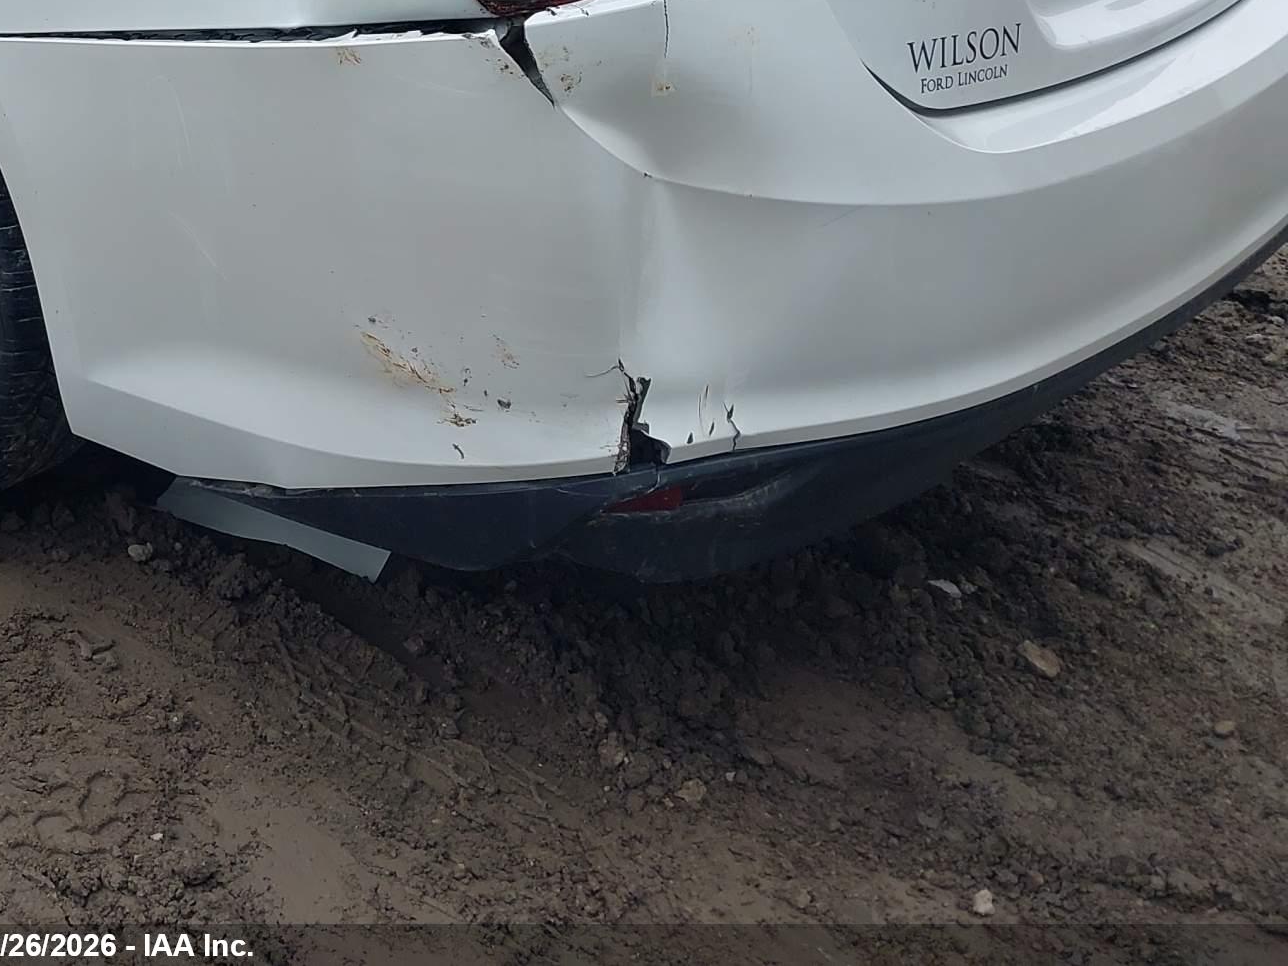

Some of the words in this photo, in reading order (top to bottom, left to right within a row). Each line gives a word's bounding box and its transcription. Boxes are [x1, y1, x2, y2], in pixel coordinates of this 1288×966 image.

[906, 22, 1022, 75] WILSON
[920, 75, 954, 94] FORD
[957, 63, 1009, 87] LINCOLN
